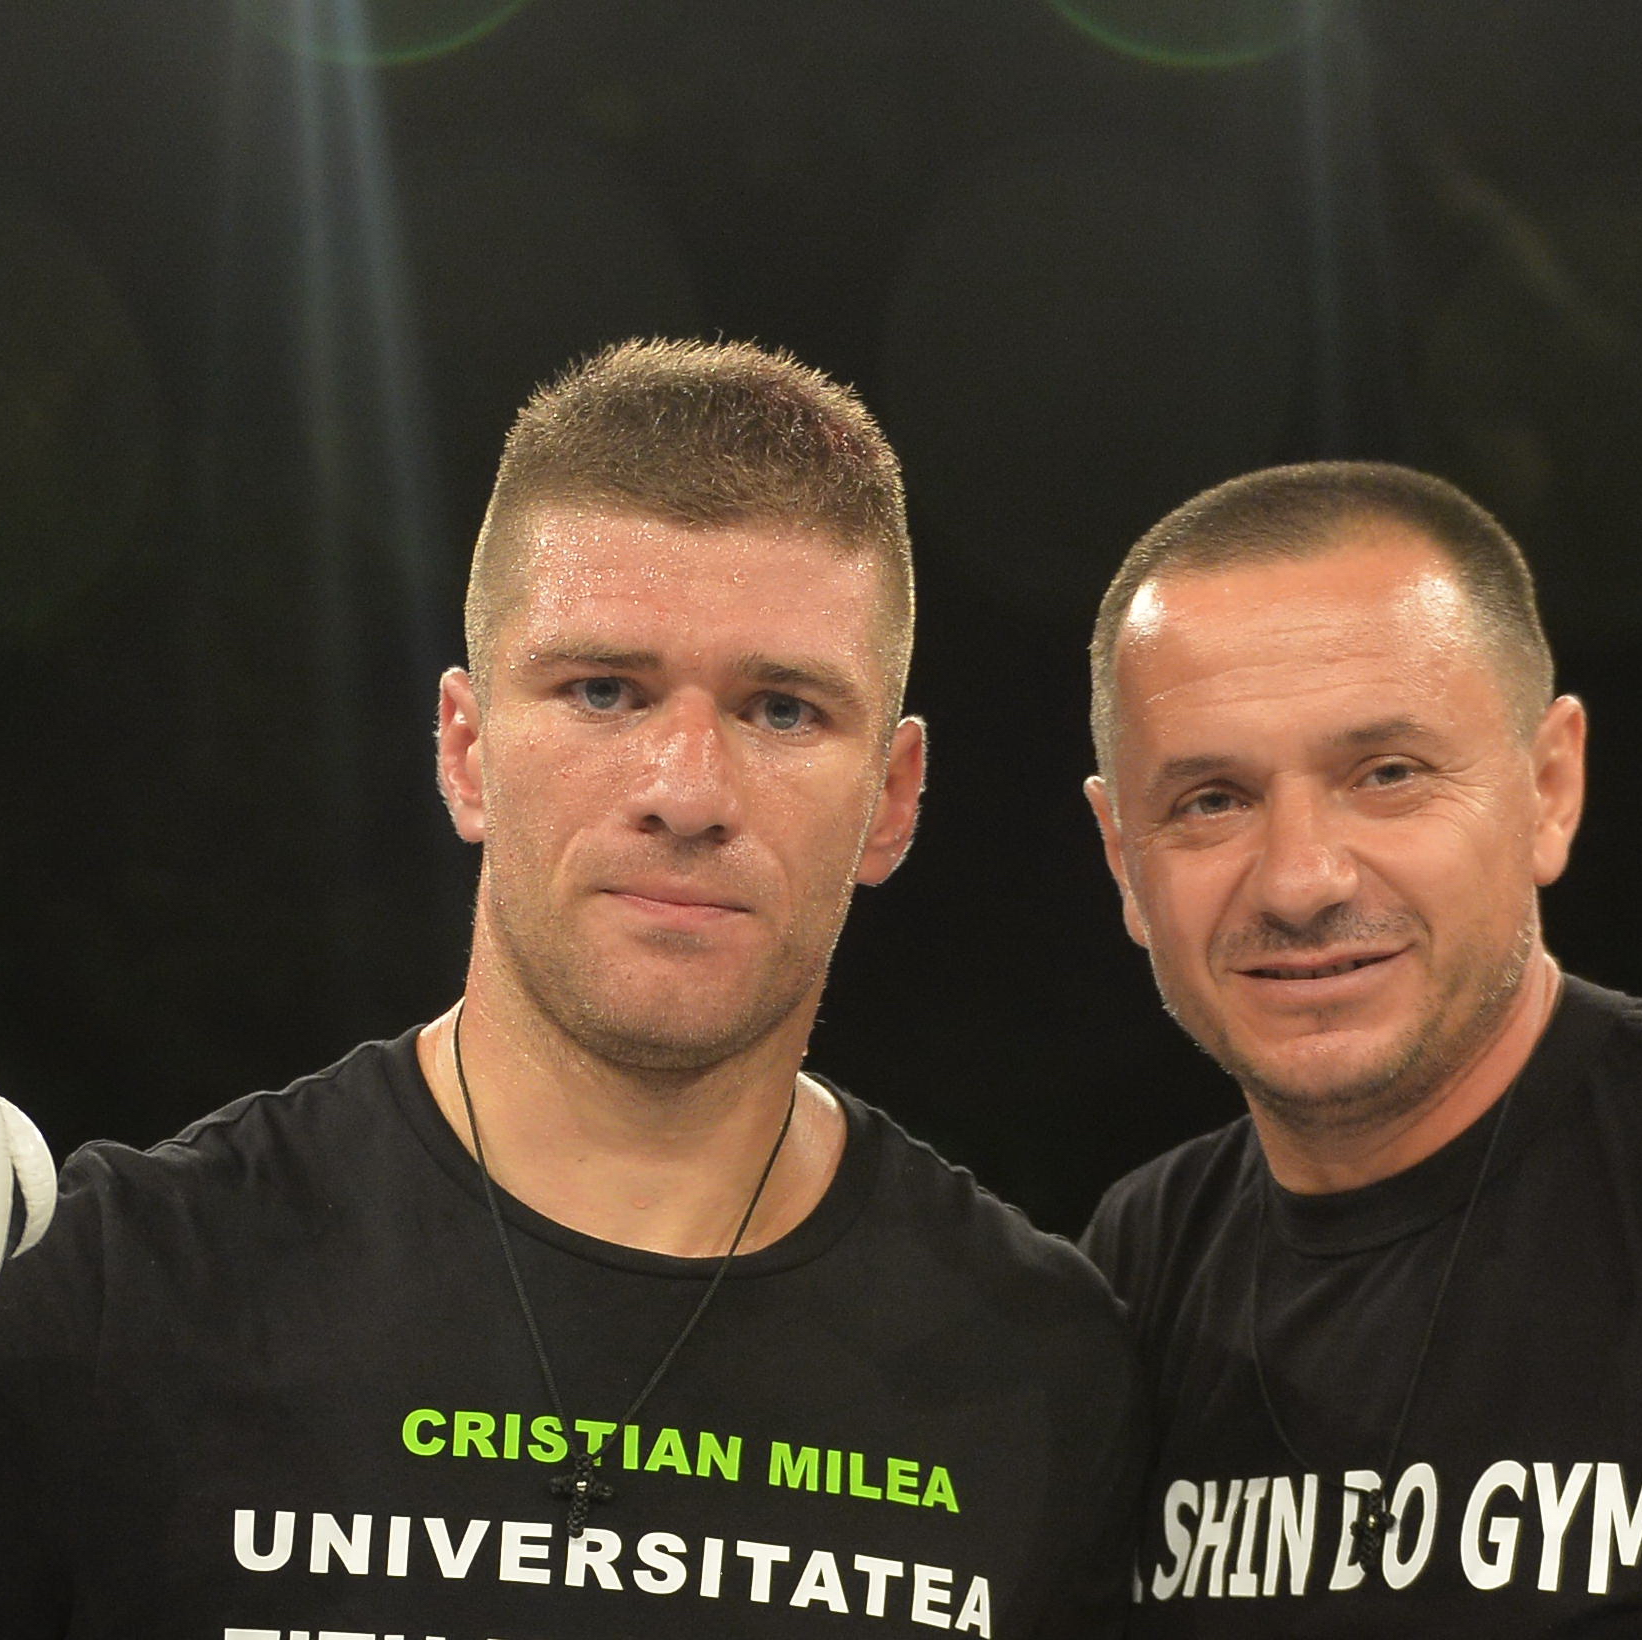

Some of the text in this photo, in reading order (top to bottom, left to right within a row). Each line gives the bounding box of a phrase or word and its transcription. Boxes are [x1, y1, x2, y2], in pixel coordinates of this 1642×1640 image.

[401, 1408, 960, 1514] CRISTIAN MILEA
[233, 1509, 992, 1640] UNIVERSITATEA
[1151, 1473, 1319, 1601] SHIN
[1327, 1462, 1439, 1592] DO
